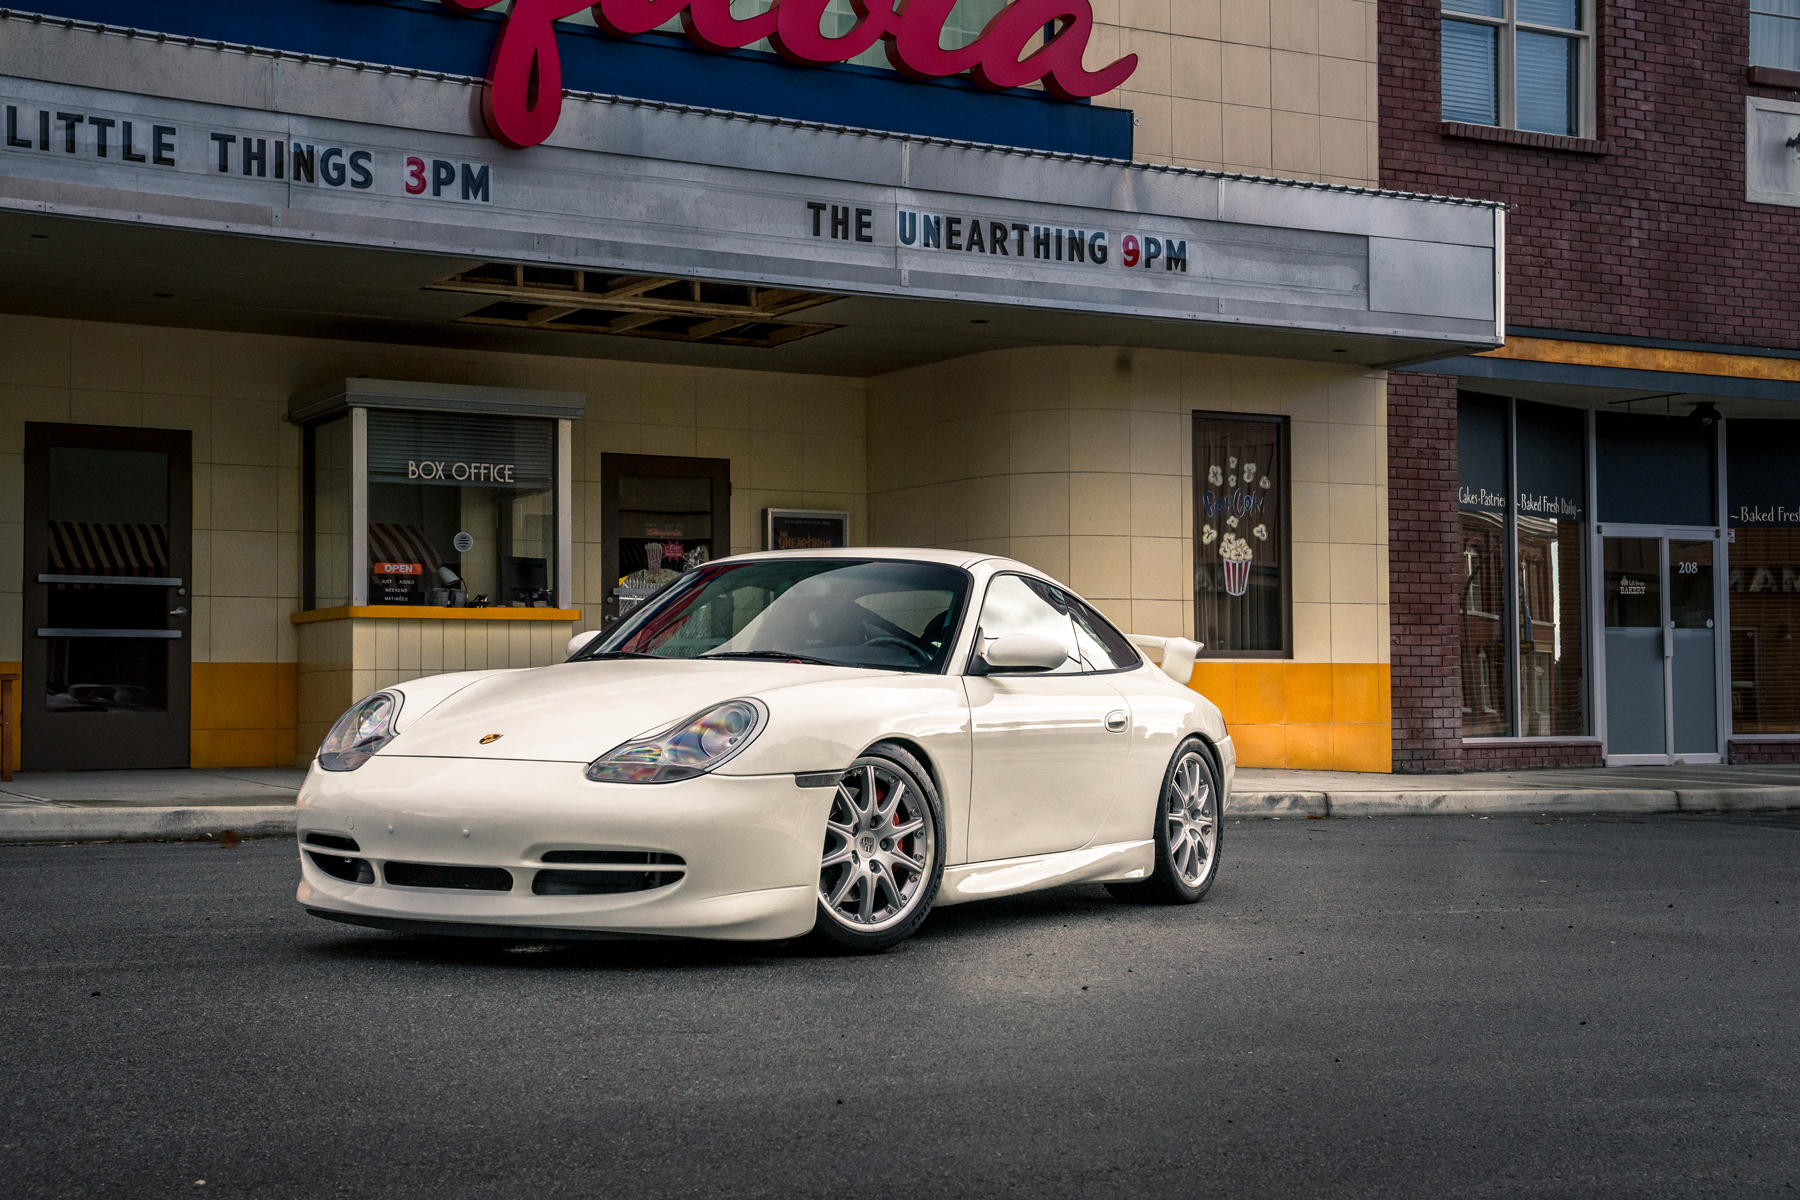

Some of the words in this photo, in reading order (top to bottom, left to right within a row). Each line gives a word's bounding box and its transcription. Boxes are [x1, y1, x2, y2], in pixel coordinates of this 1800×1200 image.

[7, 106, 176, 166] LITTLE
[211, 133, 373, 189] THINGS
[405, 157, 489, 202] 3PM
[807, 202, 872, 243] THE
[899, 211, 1108, 265] UNEARTHING
[1122, 235, 1186, 272] 9PM
[409, 461, 445, 480] BOX
[452, 463, 514, 482] OFFICE
[1543, 496, 1559, 513] Fresh
[384, 564, 413, 573] OPEN
[1678, 561, 1698, 574] 208
[1620, 586, 1646, 595] BAKERY
